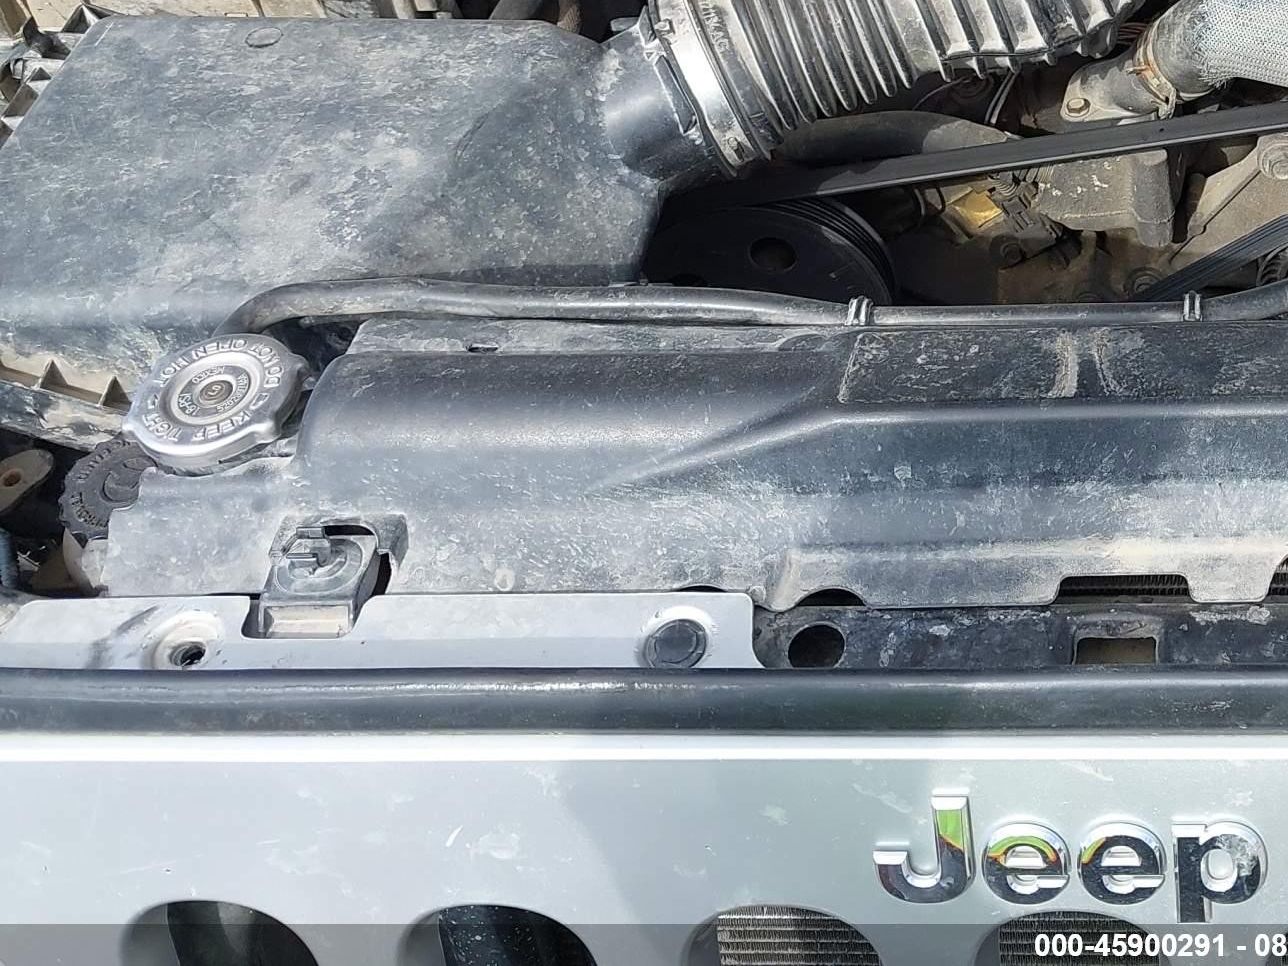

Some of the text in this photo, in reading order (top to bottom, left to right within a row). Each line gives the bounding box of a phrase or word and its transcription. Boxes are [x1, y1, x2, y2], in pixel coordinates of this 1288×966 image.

[153, 337, 285, 388] DO NOT OPEN HOT
[142, 409, 252, 443] KEEP TIGHT
[873, 787, 1268, 922] Jeep
